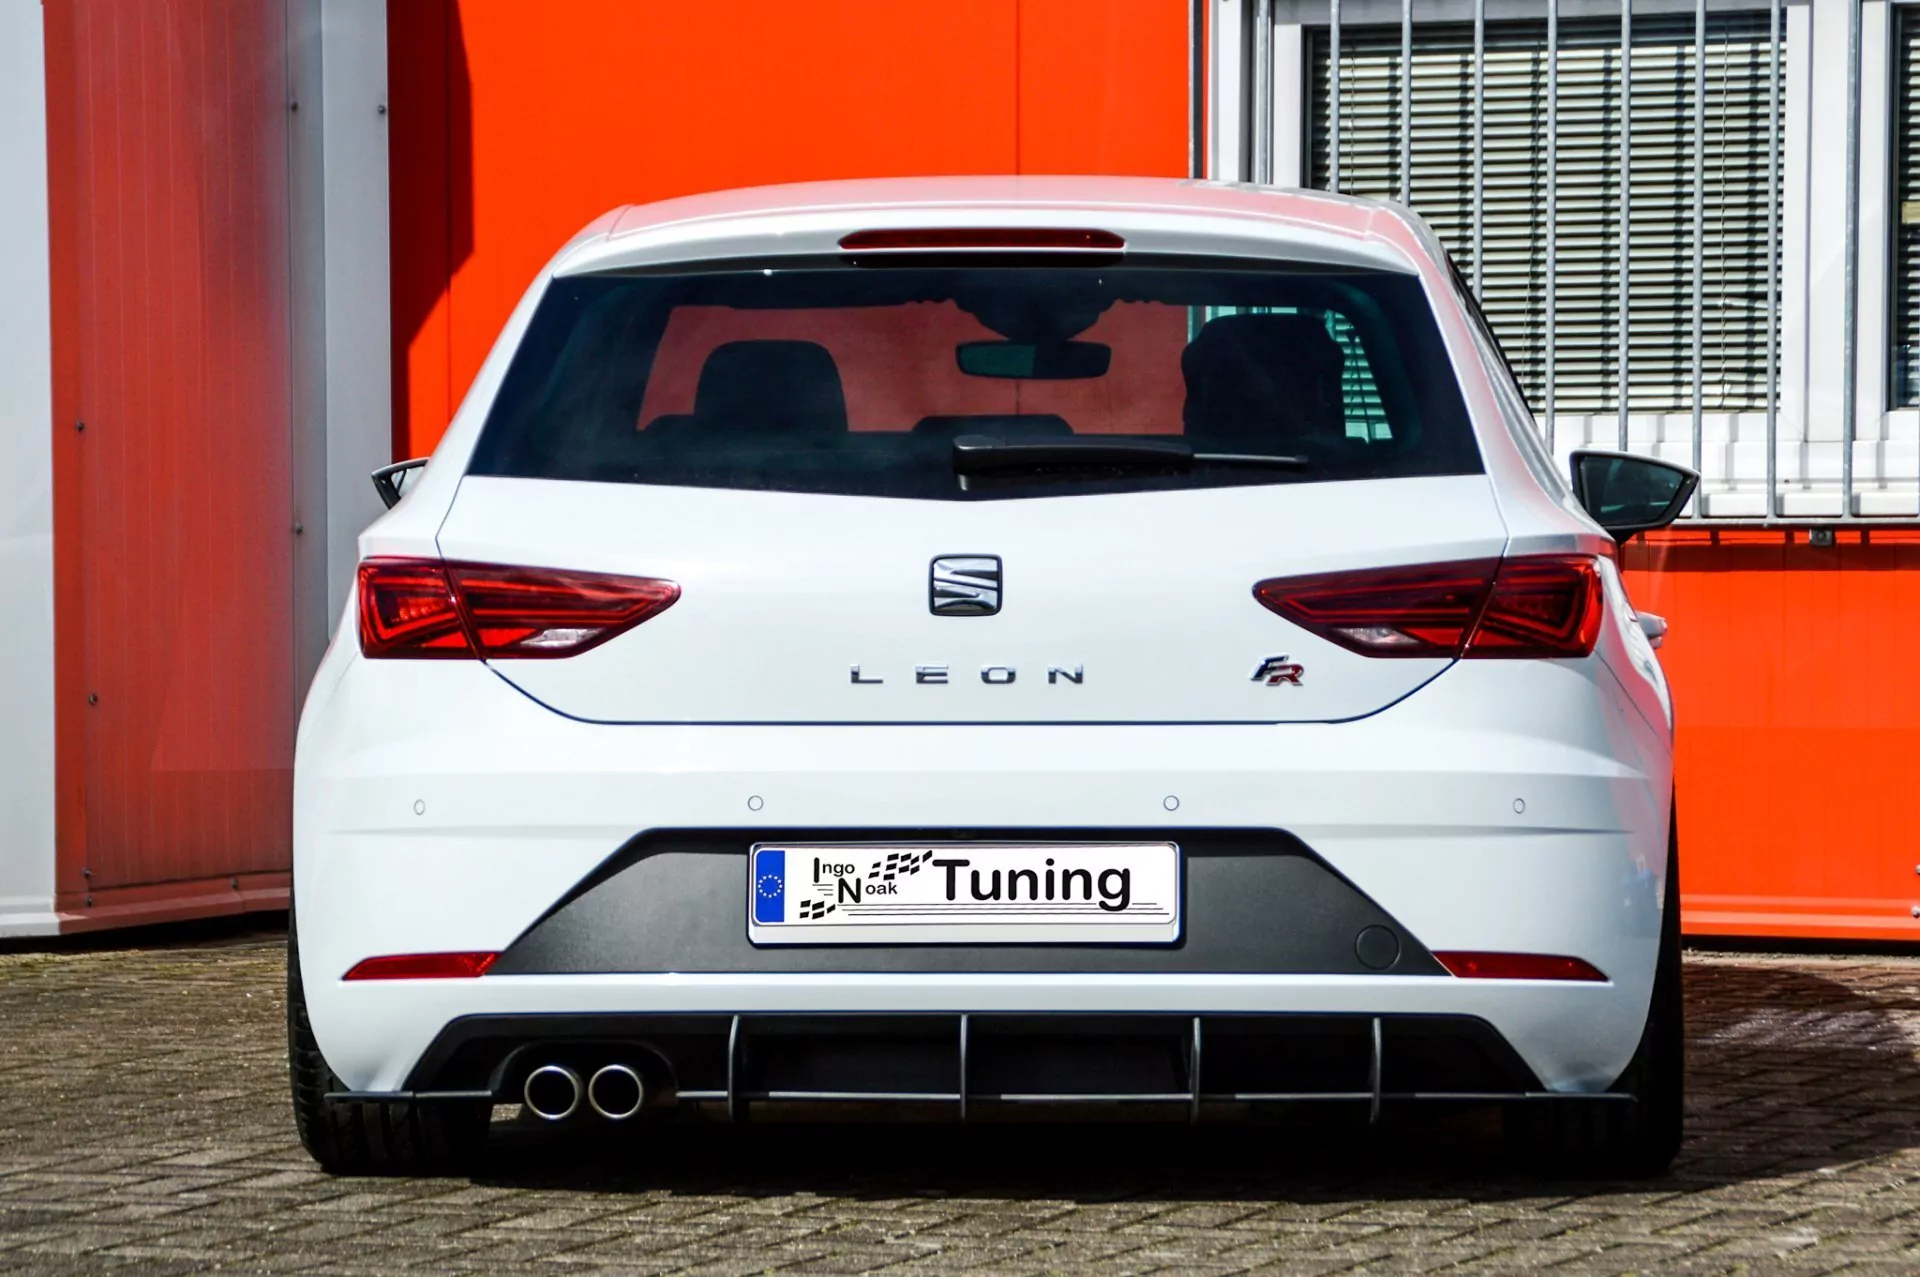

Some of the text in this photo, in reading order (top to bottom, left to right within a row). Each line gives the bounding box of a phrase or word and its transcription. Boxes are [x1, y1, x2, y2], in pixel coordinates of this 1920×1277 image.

[850, 664, 1084, 685] LEON
[1250, 653, 1305, 687] FR
[813, 857, 856, 883] Ingo
[838, 877, 898, 904] Noak
[932, 857, 1131, 912] Tuning
